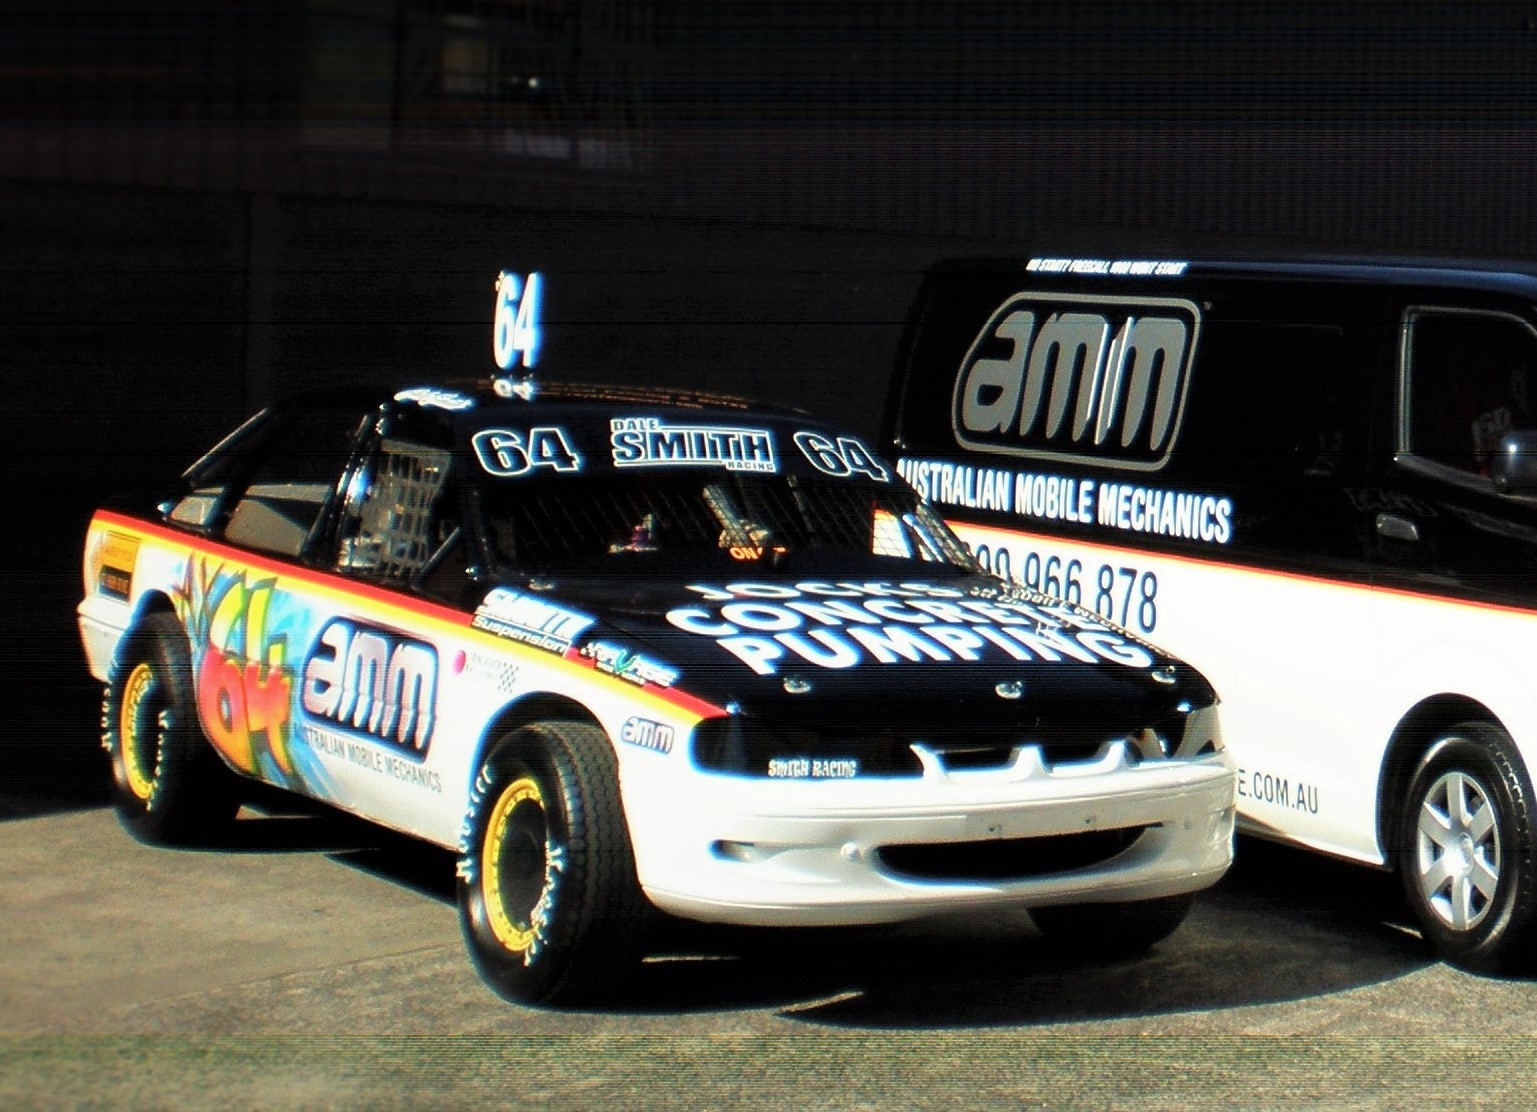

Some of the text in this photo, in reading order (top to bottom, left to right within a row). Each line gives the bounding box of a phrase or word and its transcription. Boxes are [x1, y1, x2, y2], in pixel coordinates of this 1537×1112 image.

[494, 270, 538, 368] 64
[962, 310, 1187, 451] amm
[611, 419, 660, 431] DALE
[612, 431, 774, 462] SMITH
[473, 428, 580, 477] 64
[727, 461, 775, 471] RACING
[794, 430, 888, 482] 64
[1015, 473, 1093, 524] MOBILE
[1098, 484, 1232, 543] MECHANICS
[667, 599, 1112, 636] CONCRETE
[1096, 563, 1158, 634] 878
[717, 624, 1152, 676] PUMPING
[304, 622, 436, 750] amm
[624, 718, 673, 752] amm
[812, 760, 857, 777] RACING
